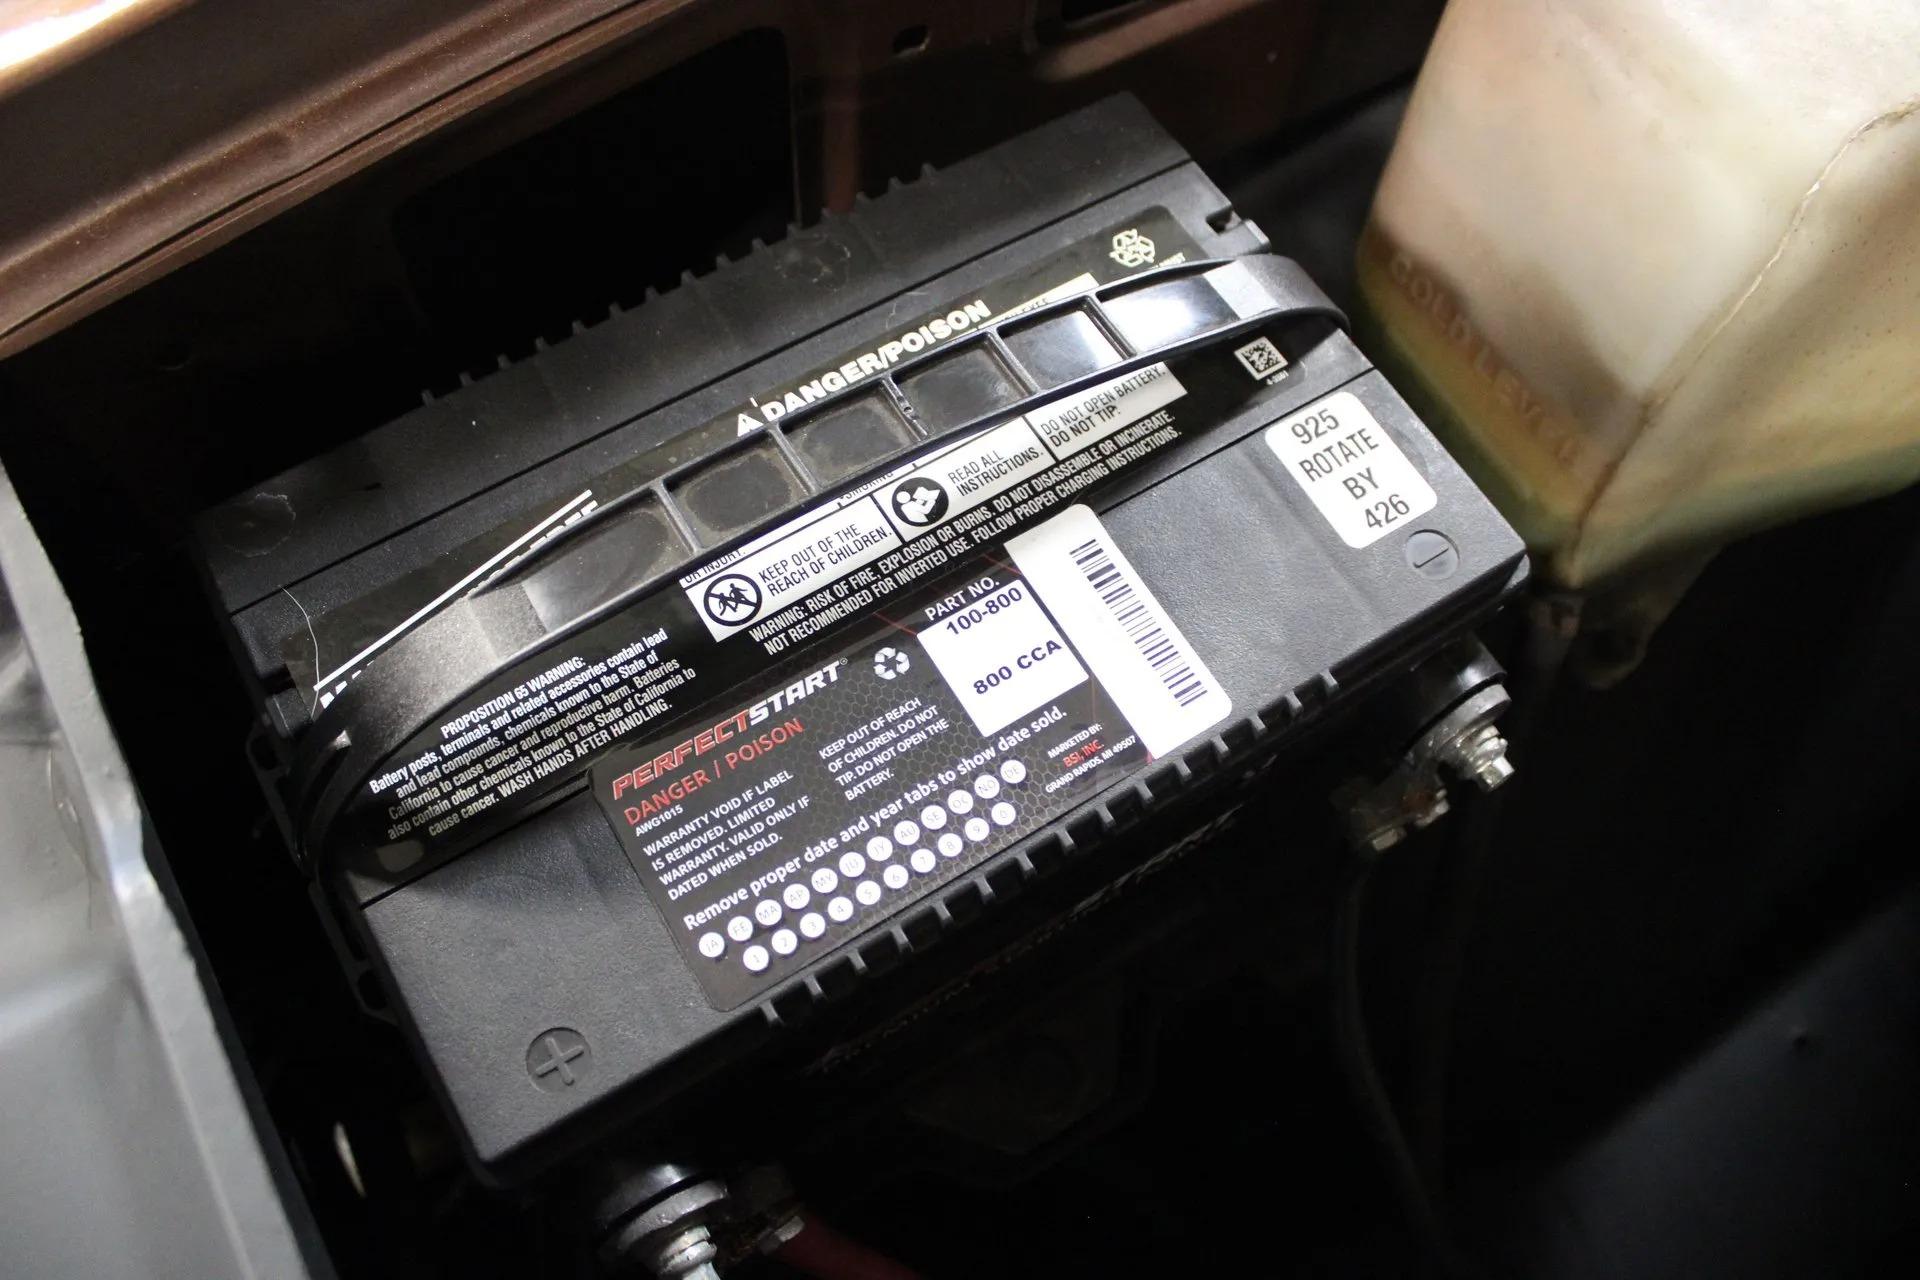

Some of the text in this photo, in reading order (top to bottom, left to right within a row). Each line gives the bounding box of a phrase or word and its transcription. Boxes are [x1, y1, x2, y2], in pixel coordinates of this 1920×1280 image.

[760, 299, 992, 423] DANGER/POISON
[1040, 366, 1168, 436] DO NOT OPEN BATTERY.
[1049, 430, 1071, 448] DO
[1068, 415, 1096, 437] NOT
[1291, 409, 1340, 445] 925
[947, 450, 1004, 484] READ ALL
[956, 446, 1044, 497] INSTRUCTIONS.
[1298, 428, 1379, 482] ROTATE
[1342, 467, 1379, 500] BY
[748, 409, 1176, 642] WARNING: RISK OF FIRE, EXPLOSION OR BURNS. DO NOT DISASSEMBLE OR INCINERATE.
[763, 425, 1182, 656] NOT RECOMMENDED FOR INVERTED USE. FOLLOW PROPER CHARGING INSTRUCTIONS.
[1364, 494, 1410, 528] 426
[758, 523, 861, 586] KEEP OUT OF THE
[766, 526, 892, 597] REACH OF CHILDREN.
[924, 576, 1000, 621] PART NO.
[946, 587, 1022, 635] 100-800
[440, 656, 586, 739] PROPOSITION 65 WARNING:
[973, 640, 1062, 695] 800 CCA
[368, 627, 668, 794] Battery posts, terminals and related accessories contain lead
[388, 658, 680, 820] California to cause cancer and reproductive harm. Batteries
[395, 649, 659, 799] and lead compounds, chemicals known to the State of
[818, 697, 922, 760] KEEP OUT OF REACH
[827, 704, 939, 773] OF CHILDREN. DO NOT
[1047, 723, 1103, 759] MARKETED BY:
[387, 668, 697, 840] also contain other chemicals known to the State of California to
[428, 698, 673, 836] cause cancer. WASH HANDS AFTER HANDLING.
[623, 769, 711, 826] DANGER
[724, 717, 804, 770] POISON
[834, 718, 950, 786] TIP. DO NOT OPEN THE
[844, 767, 895, 801] BATTERY.
[1045, 734, 1136, 794] GRAND RAPIDS, MI 49507
[635, 804, 684, 837] AWG1015
[642, 770, 794, 856] WARRANTY VOID IF LABEL
[651, 797, 776, 872] IS REMOVED. LIMITED
[658, 795, 810, 886] WARRANTY. VALID ONLY IF
[683, 705, 1068, 931] Remove proper date and year tabs to show date sold.
[667, 832, 783, 901] DATED WHEN SOLD.
